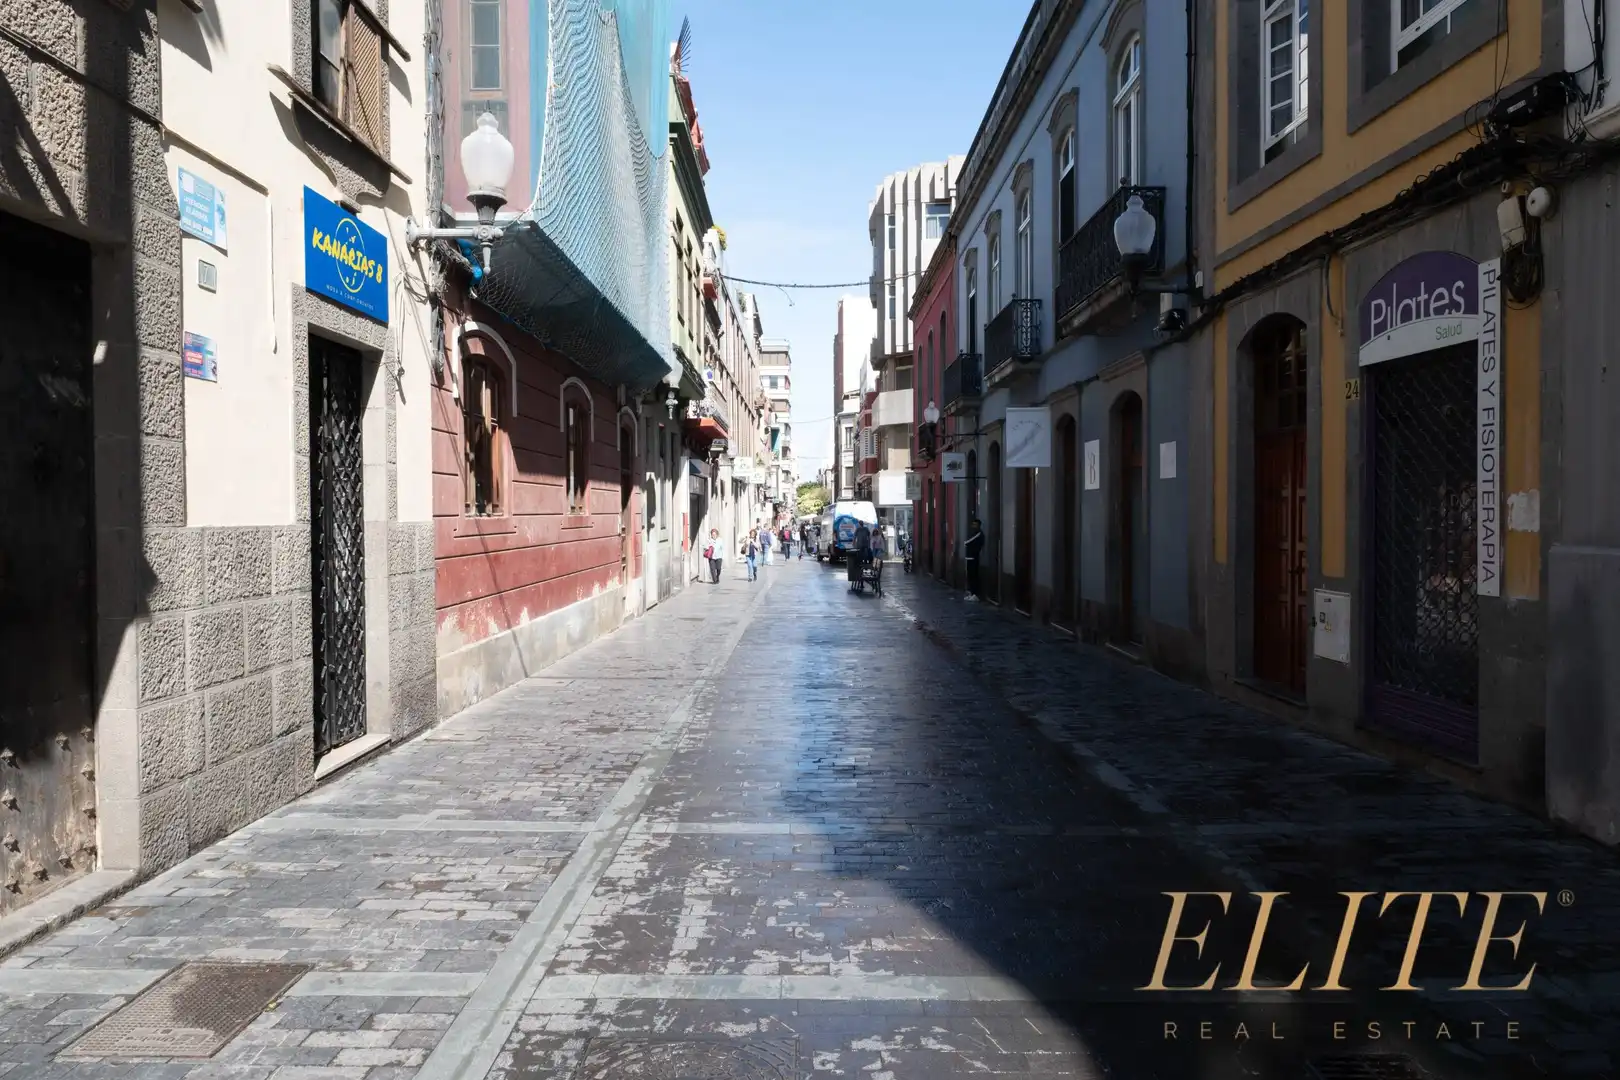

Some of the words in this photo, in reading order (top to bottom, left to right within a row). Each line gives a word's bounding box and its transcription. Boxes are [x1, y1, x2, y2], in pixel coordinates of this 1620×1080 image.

[312, 227, 376, 278] KANARIAS
[376, 264, 383, 284] 8
[1370, 280, 1465, 340] Pilates
[1435, 323, 1463, 341] Salud
[1482, 268, 1496, 373] PILATES
[1345, 381, 1359, 399] 24
[1482, 380, 1495, 397] Y
[1481, 406, 1495, 584] FISIOTERAPIA
